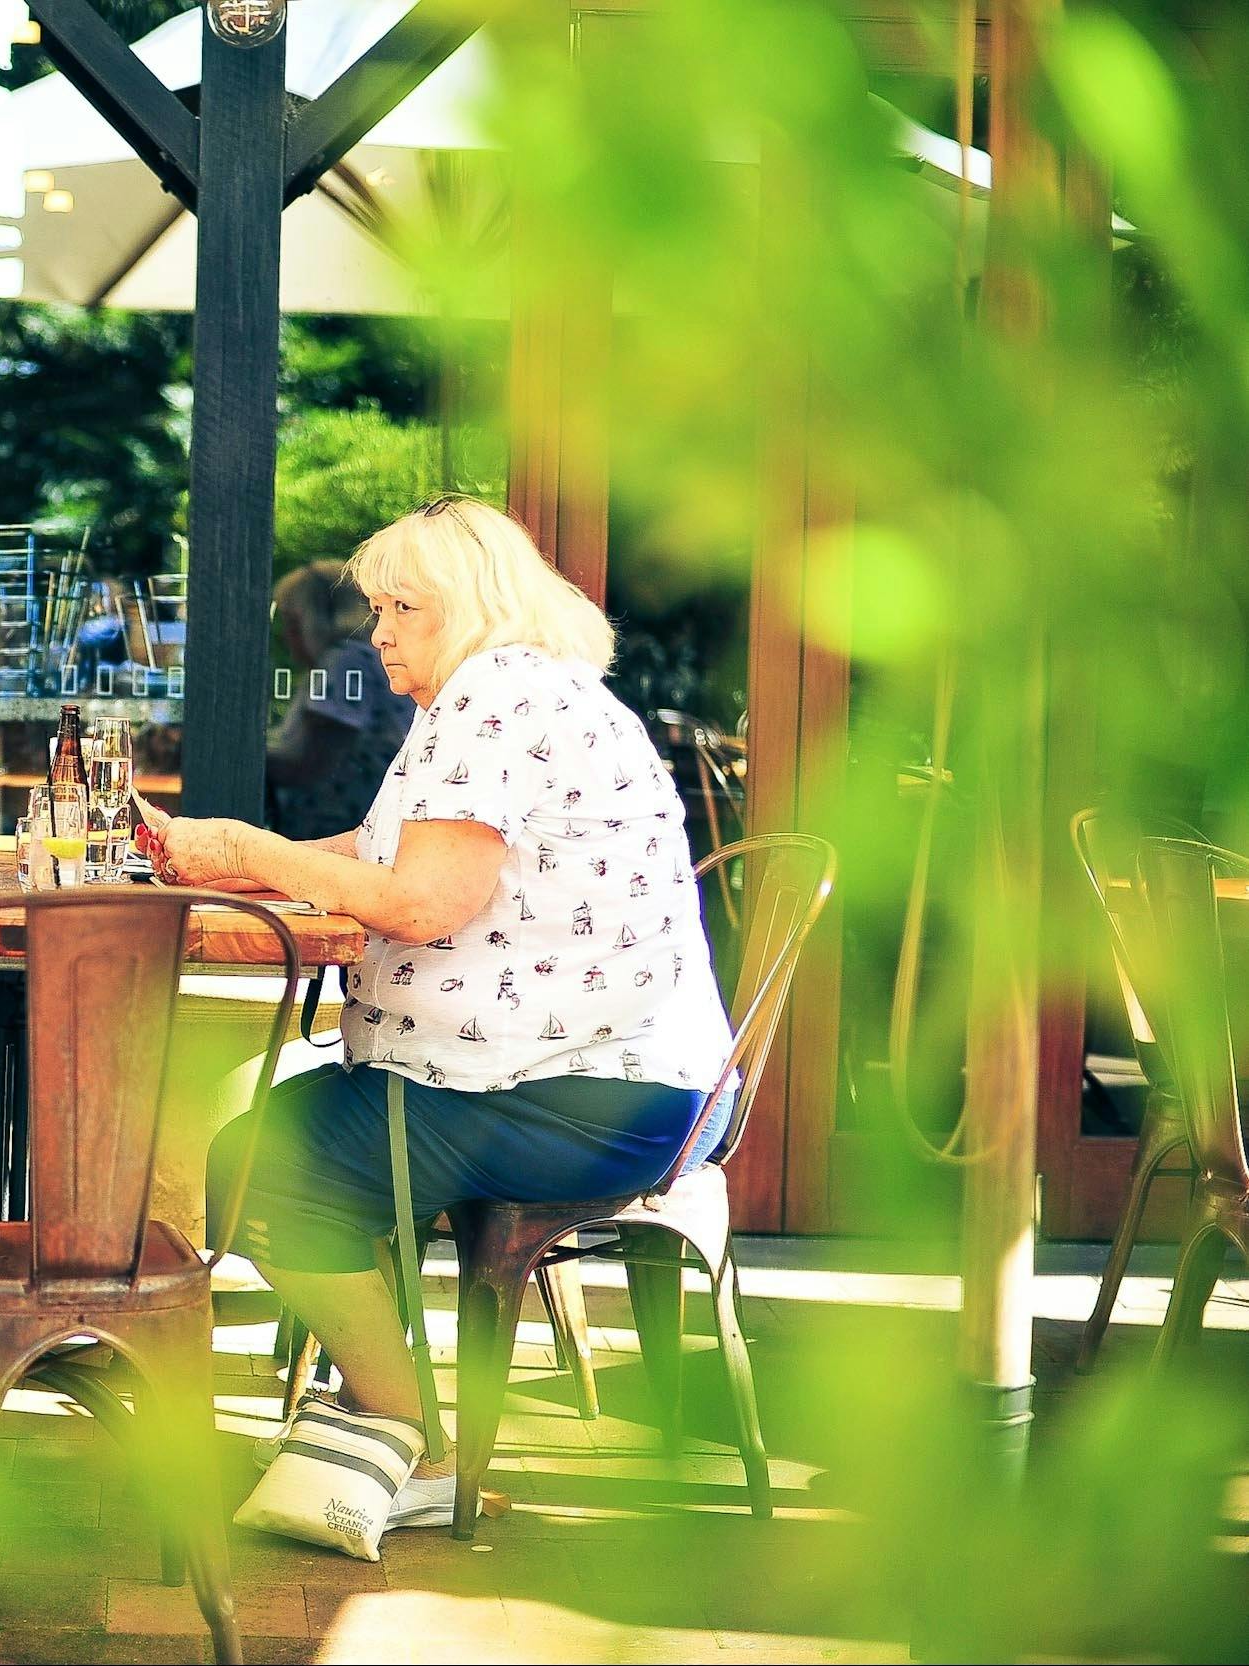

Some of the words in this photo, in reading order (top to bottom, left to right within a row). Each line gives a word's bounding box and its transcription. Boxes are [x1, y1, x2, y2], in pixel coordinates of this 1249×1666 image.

[323, 1498, 374, 1525] Nautica
[324, 1511, 368, 1532] OCEANIA
[327, 1522, 362, 1537] CRUISES
